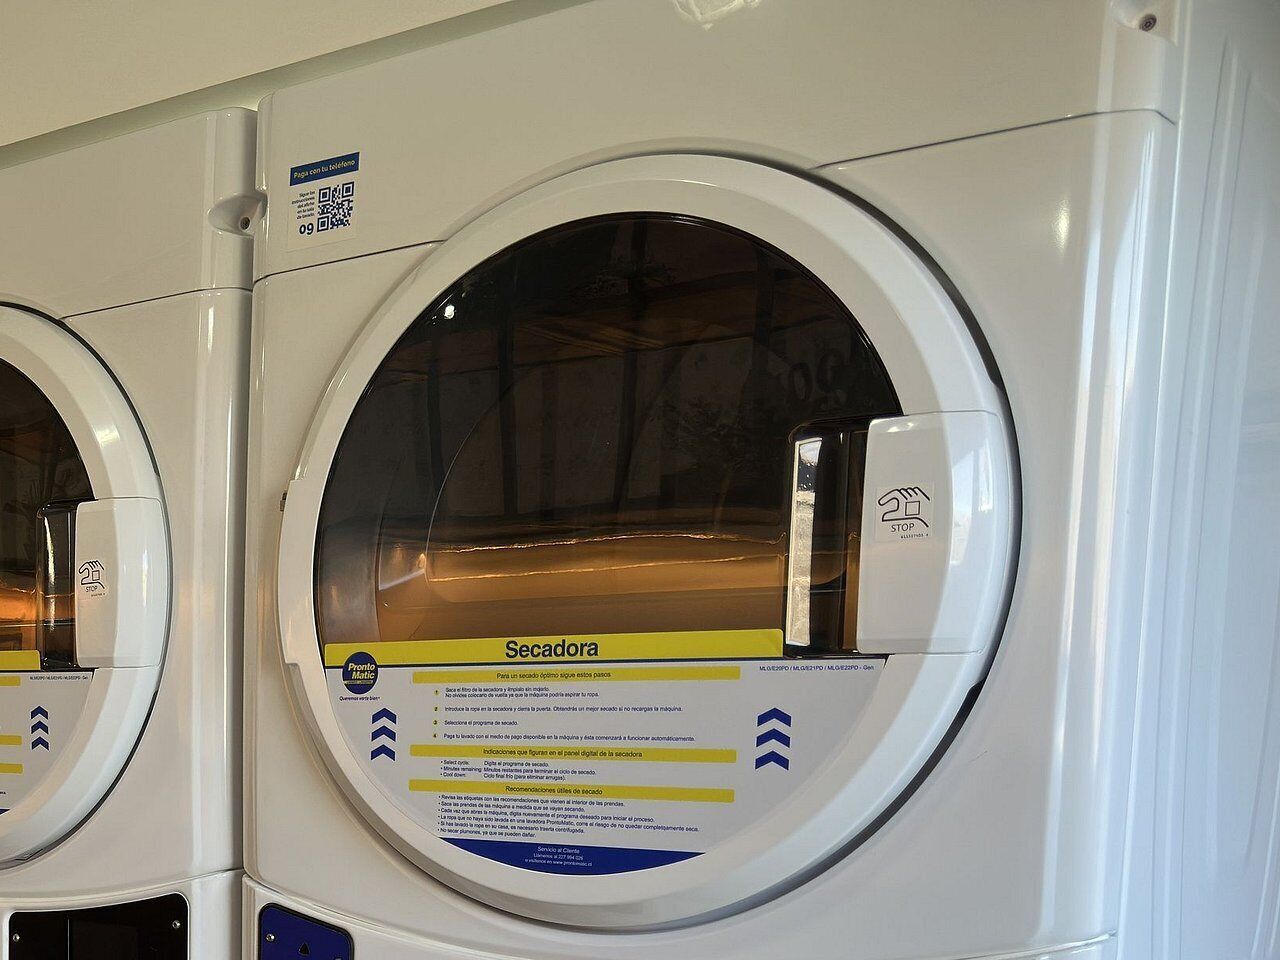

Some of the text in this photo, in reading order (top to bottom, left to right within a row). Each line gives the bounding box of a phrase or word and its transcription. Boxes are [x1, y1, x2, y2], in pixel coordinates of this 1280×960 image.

[294, 171, 308, 179] Paga
[329, 160, 355, 171] teléfono
[299, 222, 314, 236] 09
[891, 522, 915, 532] STOP
[505, 638, 598, 659] Secadora
[348, 662, 376, 672] Pronto
[352, 670, 376, 680] Matic
[540, 672, 560, 680] óptimo
[560, 671, 576, 680] sigue
[593, 672, 612, 680] pasos
[483, 748, 516, 756] Indicaciones
[528, 749, 548, 757] figuran
[564, 750, 580, 758] panel
[506, 786, 556, 794] Recomendaciones
[557, 786, 572, 794] útiles
